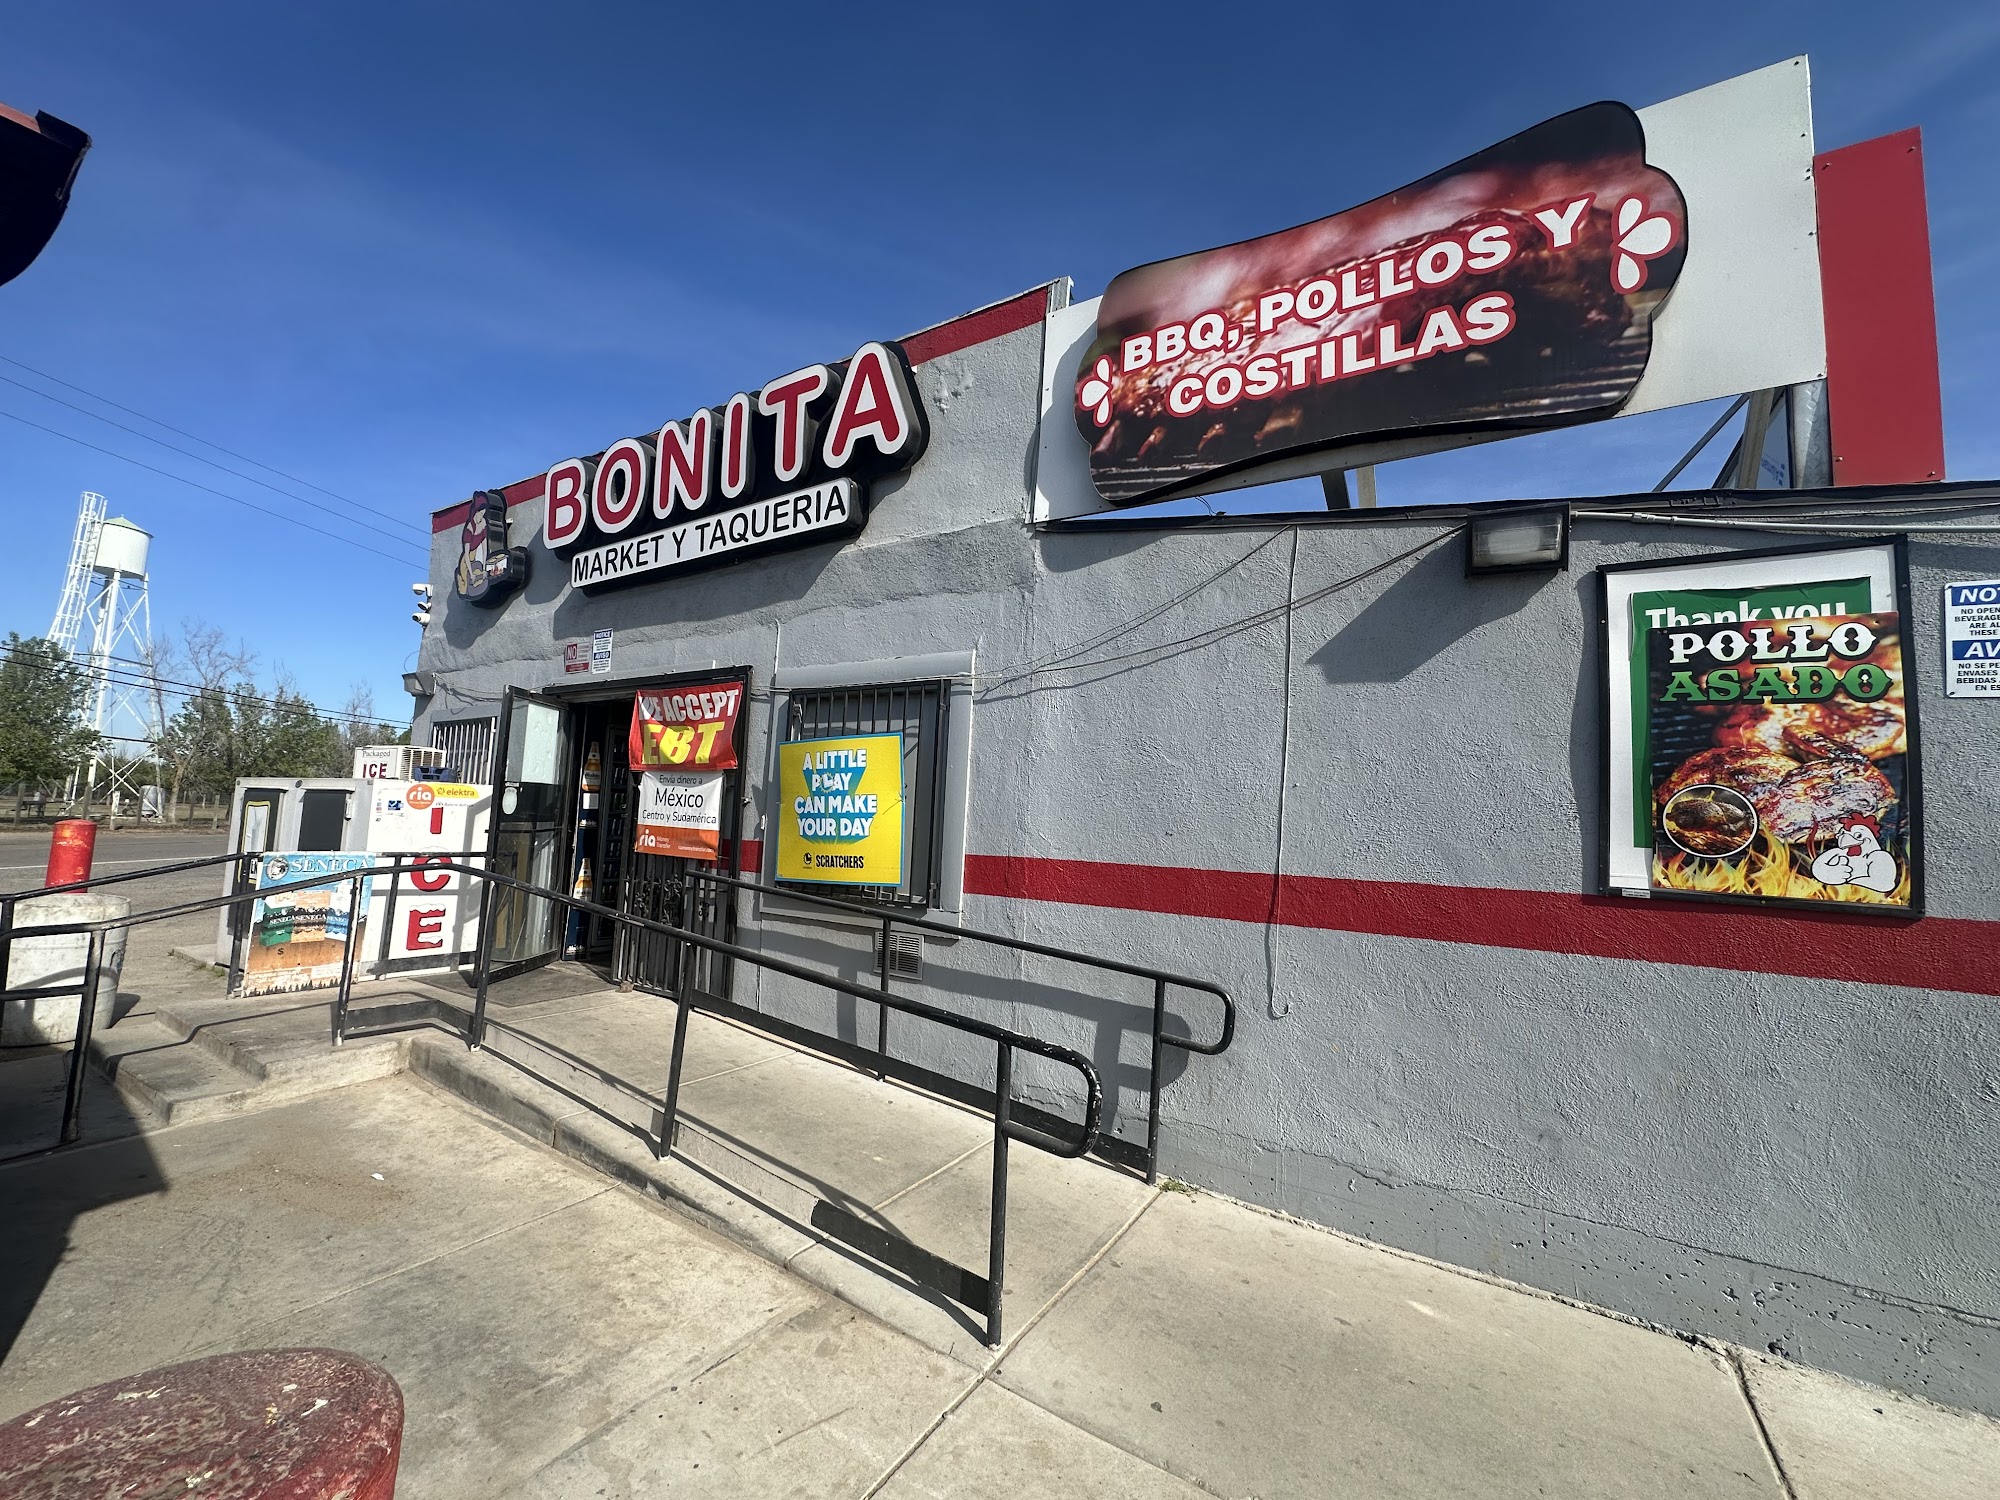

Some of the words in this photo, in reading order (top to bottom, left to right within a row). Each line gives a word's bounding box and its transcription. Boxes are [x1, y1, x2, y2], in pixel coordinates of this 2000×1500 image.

[1123, 312, 1241, 373] BBQ,
[1259, 225, 1512, 333] POLLOS
[1535, 197, 1591, 249] Y
[1169, 295, 1512, 416] COSTILLAS
[543, 341, 909, 550] BONITA
[574, 534, 664, 583] MARKET
[671, 529, 687, 558] Y
[695, 485, 847, 552] TAQUERIA
[1645, 601, 1763, 628] Thank
[567, 645, 577, 660] NO
[1669, 622, 1877, 664] POLLO
[1659, 663, 1893, 702] ASADO
[638, 696, 663, 721] WE
[663, 689, 739, 722] ACCEPT
[641, 721, 726, 765] EBT
[362, 750, 391, 758] Packaged
[802, 751, 813, 770] A
[816, 749, 867, 769] LITTLE
[362, 763, 388, 779] ICE
[660, 774, 676, 784] Envía
[676, 775, 697, 785] dinero
[812, 772, 853, 792] PLAY
[409, 786, 432, 800] ria
[446, 788, 475, 797] elektra
[654, 787, 704, 808] México
[794, 795, 825, 814] CAN
[828, 794, 878, 814] MAKE
[642, 809, 665, 821] Centro
[666, 813, 672, 823] y
[672, 811, 717, 824] Sudamérica
[797, 817, 837, 837] YOUR
[840, 817, 874, 836] DAY
[639, 828, 656, 848] ria
[290, 858, 370, 873] SENECA
[815, 854, 865, 869] SCRATCHERS
[277, 947, 285, 956] $
